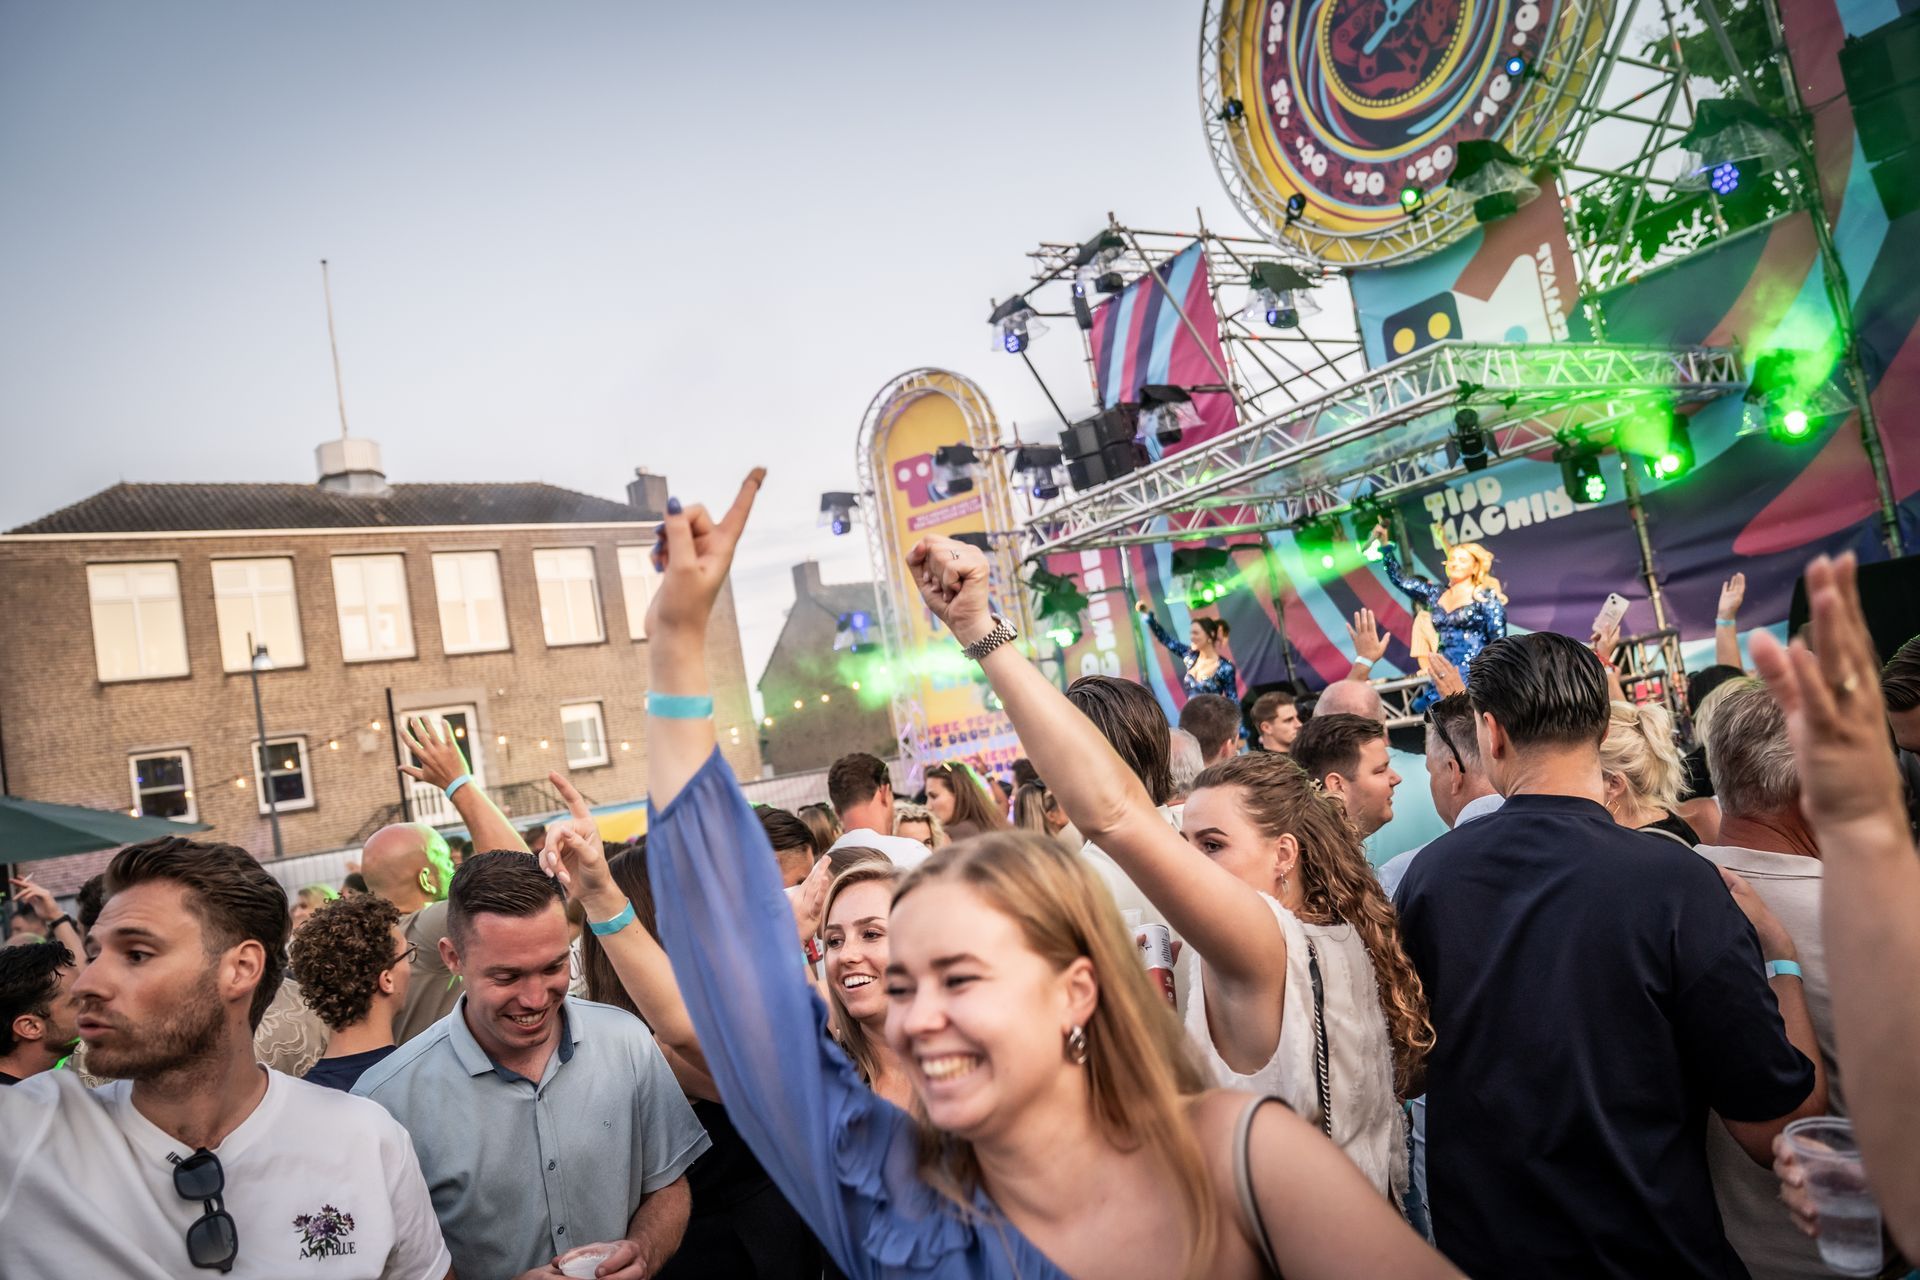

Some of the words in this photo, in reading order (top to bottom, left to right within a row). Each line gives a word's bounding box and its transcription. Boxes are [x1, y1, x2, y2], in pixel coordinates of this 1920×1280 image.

[1296, 135, 1327, 177] '40
[1344, 171, 1385, 196] '30
[1536, 242, 1570, 341] ESTIVAL
[1423, 476, 1502, 521] TIJD
